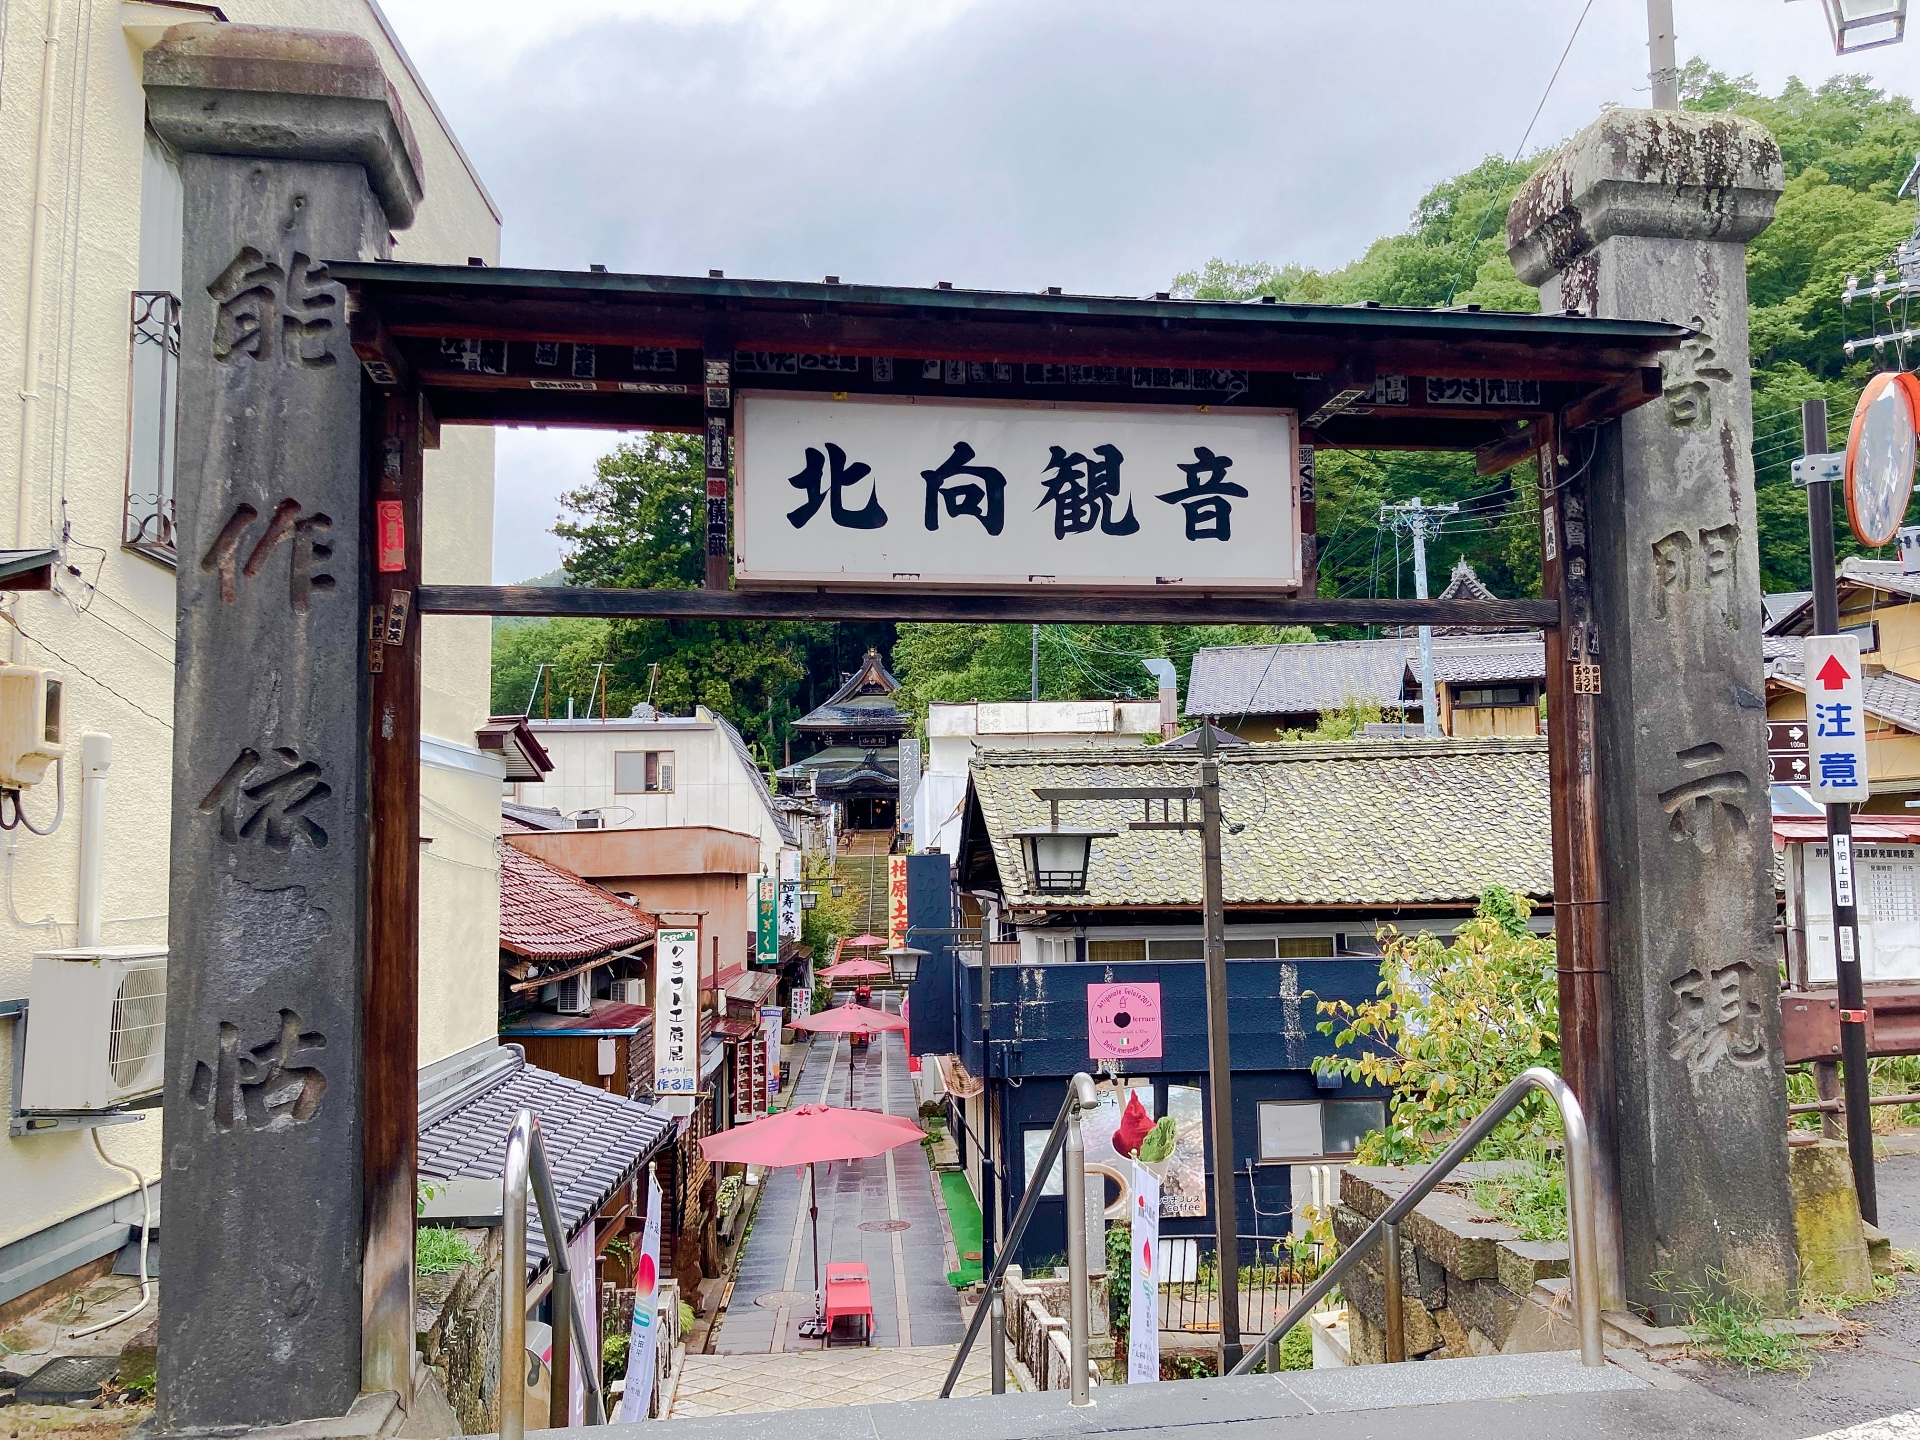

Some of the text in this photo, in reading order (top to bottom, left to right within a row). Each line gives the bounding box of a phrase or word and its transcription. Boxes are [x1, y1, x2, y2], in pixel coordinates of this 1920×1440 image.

[786, 440, 1249, 542] 北向観音
[1816, 702, 1859, 788] 注意
[901, 745, 912, 814] スケッチブック
[760, 903, 773, 950] 野ぎく
[889, 859, 908, 950] 柏原土産
[661, 930, 695, 942] CRAFT
[656, 1078, 695, 1091] 作る屋
[1167, 1203, 1201, 1212] coffee
